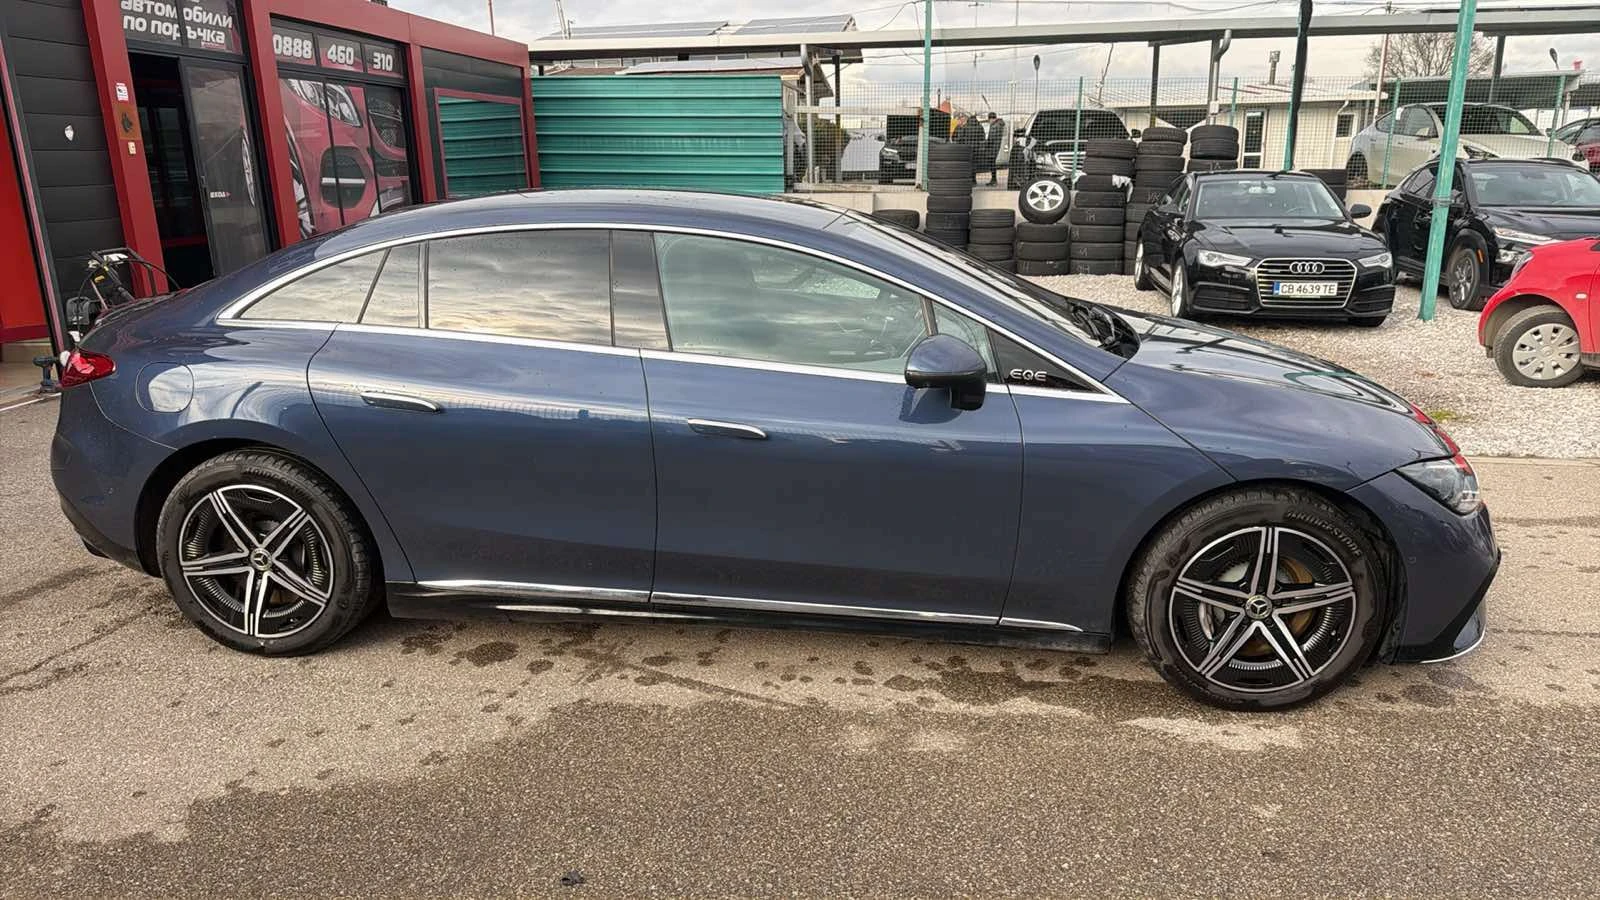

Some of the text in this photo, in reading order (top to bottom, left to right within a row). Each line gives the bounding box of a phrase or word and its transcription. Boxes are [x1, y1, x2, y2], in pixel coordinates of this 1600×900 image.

[120, 0, 233, 28] автомобили
[123, 15, 226, 44] по поръчка
[272, 34, 393, 71] 0888 460 310
[1280, 284, 1336, 294] CB 4639 TE
[1010, 368, 1047, 381] EQE
